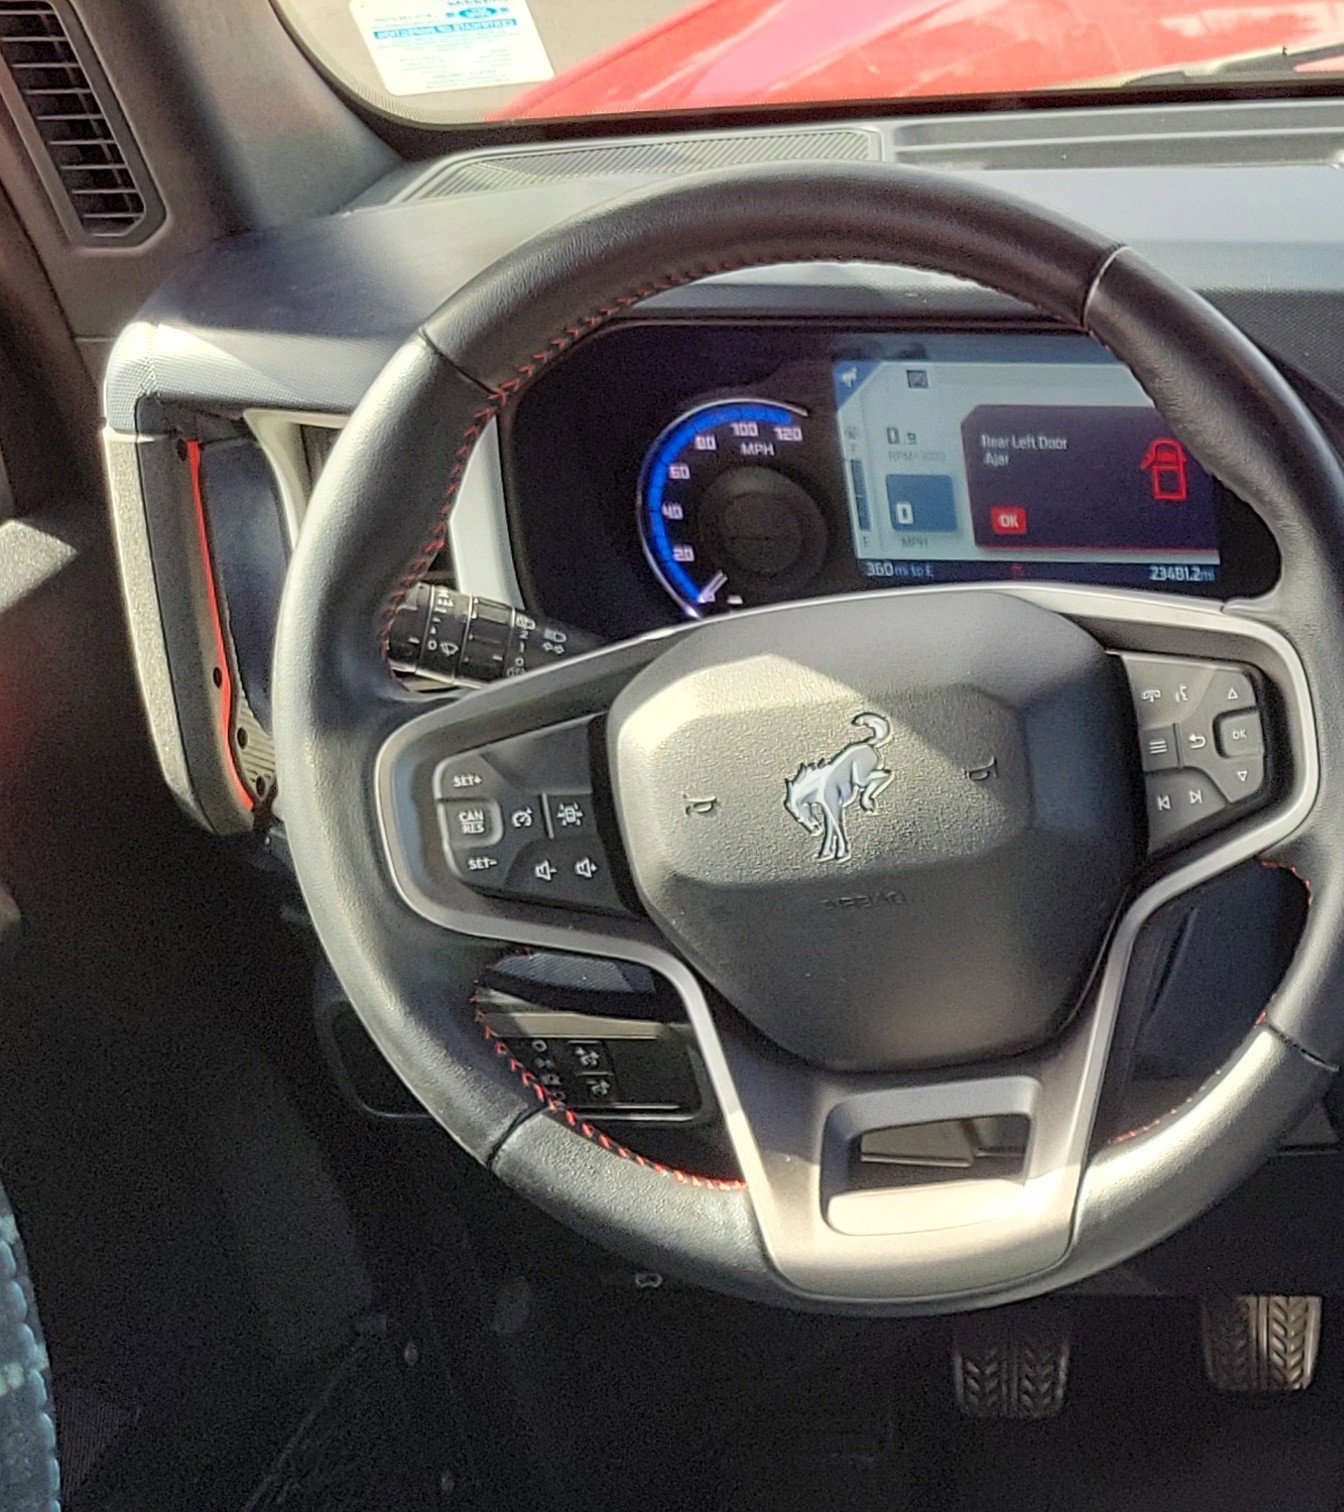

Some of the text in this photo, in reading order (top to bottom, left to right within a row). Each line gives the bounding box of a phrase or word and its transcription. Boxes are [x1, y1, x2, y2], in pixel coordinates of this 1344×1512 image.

[731, 422, 758, 437] 100
[774, 427, 803, 441] 120
[1012, 435, 1036, 449] Left
[740, 443, 775, 456] MPH
[662, 503, 683, 519] 40
[999, 513, 1019, 528] OK
[1233, 729, 1247, 740] OK
[459, 809, 484, 822] CAN
[461, 822, 485, 834] RES
